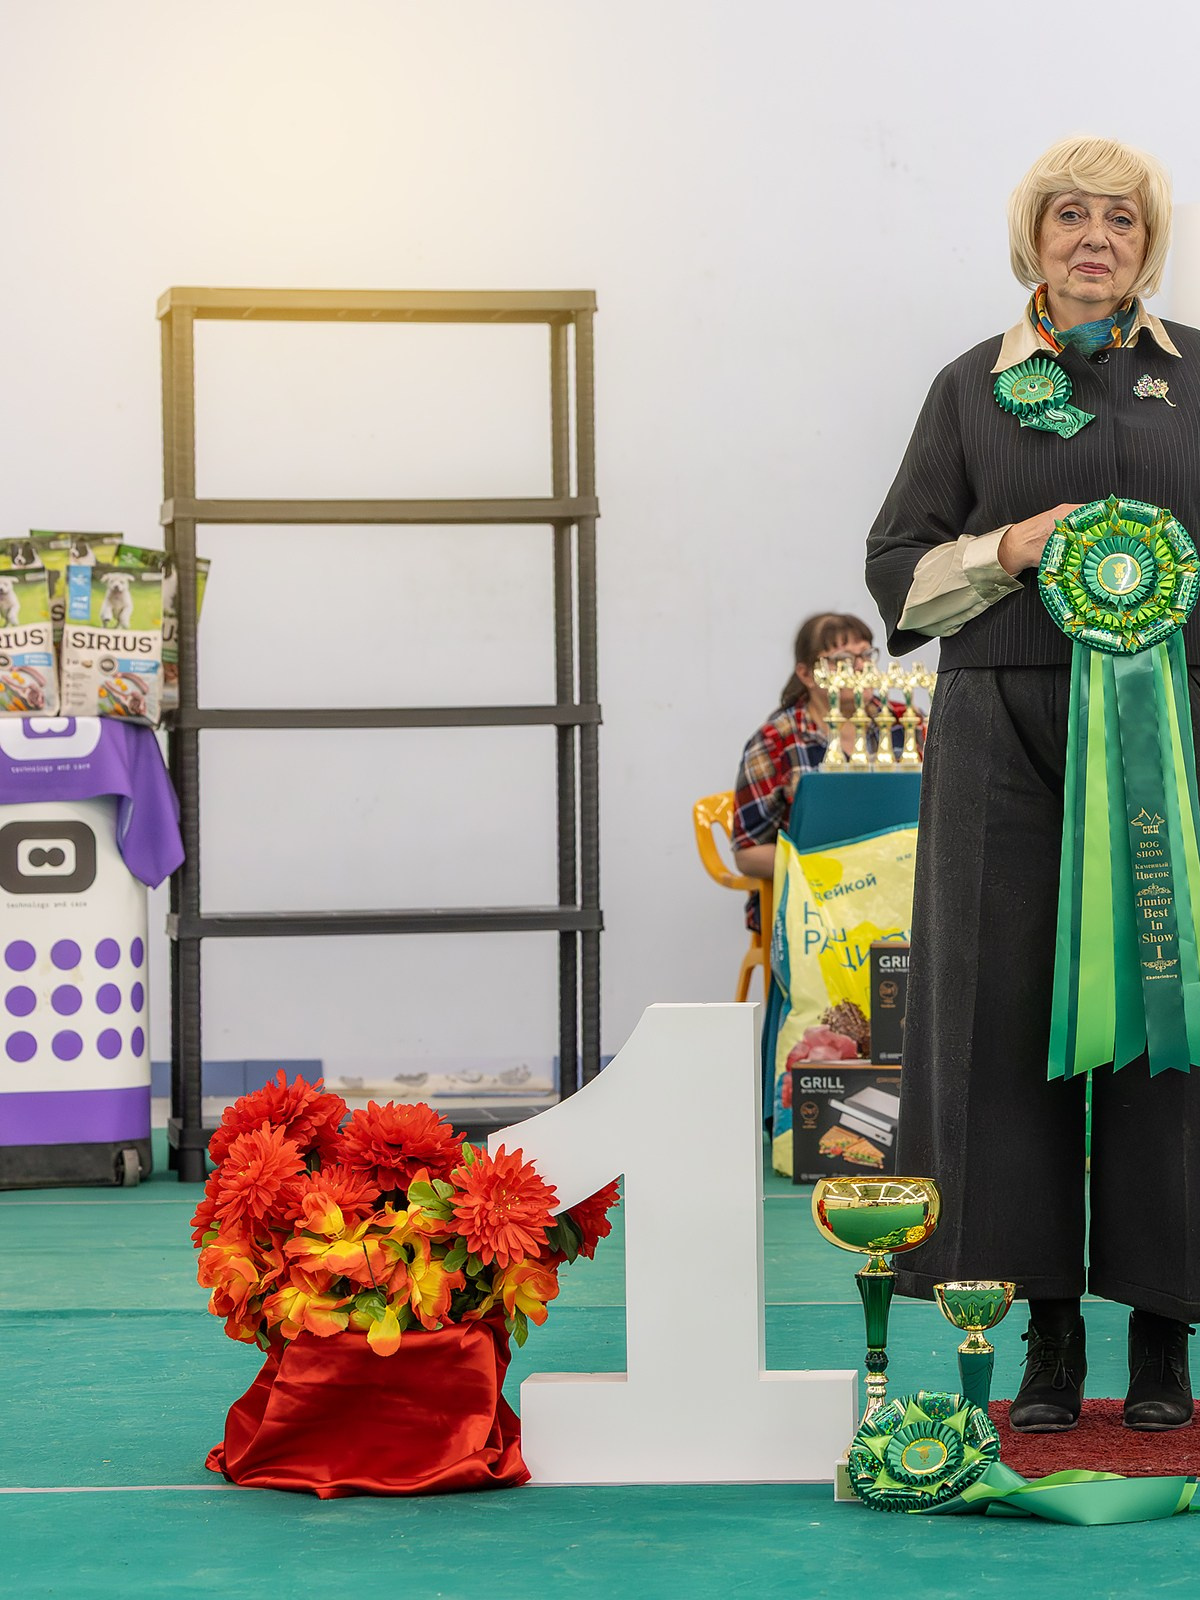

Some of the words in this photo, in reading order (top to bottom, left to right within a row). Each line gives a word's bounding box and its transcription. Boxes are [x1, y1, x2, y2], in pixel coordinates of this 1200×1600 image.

[72, 632, 152, 653] SIRIUS
[1140, 841, 1160, 849] DOG
[1136, 849, 1164, 858] SHOW
[1136, 871, 1169, 881] Цветок
[1136, 896, 1173, 907] Junior
[1144, 908, 1168, 918] Best
[1151, 920, 1163, 930] In
[1142, 932, 1174, 944] Show
[800, 1076, 845, 1089] GRILL
